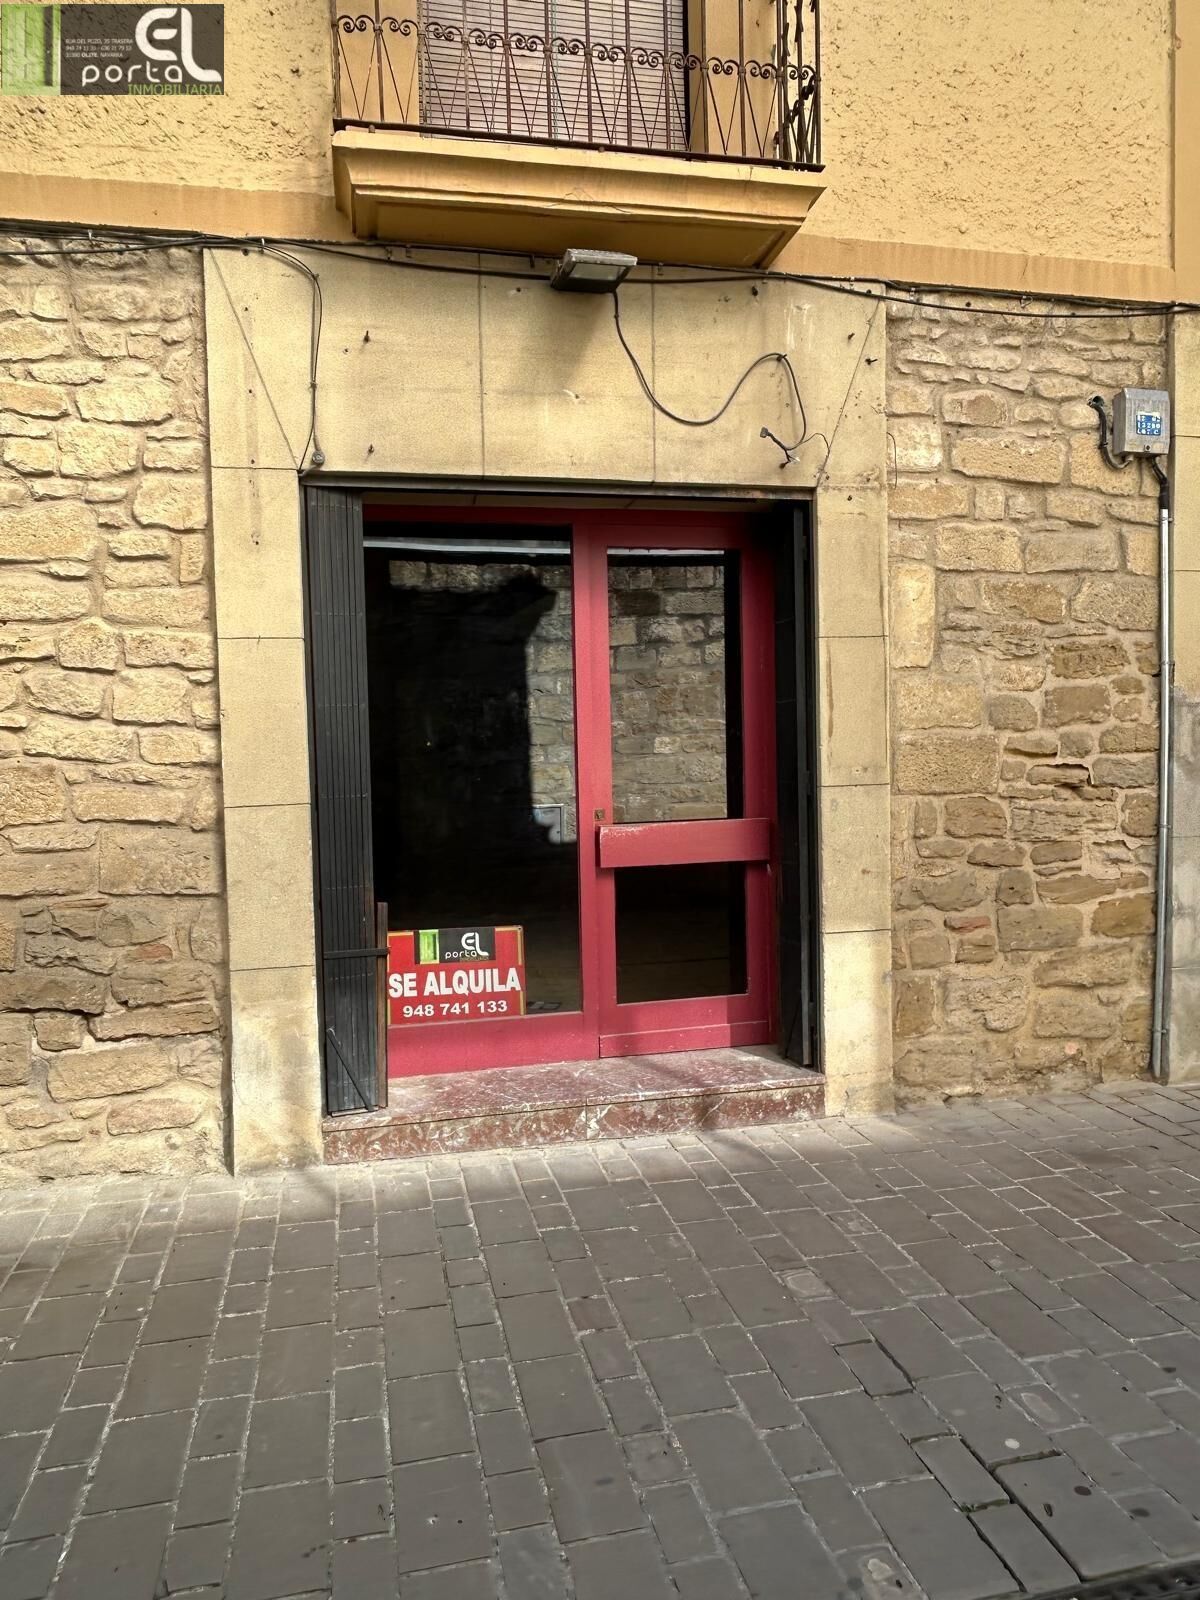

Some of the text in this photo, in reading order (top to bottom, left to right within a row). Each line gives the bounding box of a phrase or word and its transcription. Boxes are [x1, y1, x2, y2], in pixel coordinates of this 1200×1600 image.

[388, 967, 521, 998] SE ALQUILA
[402, 1000, 508, 1018] 948 741 133
